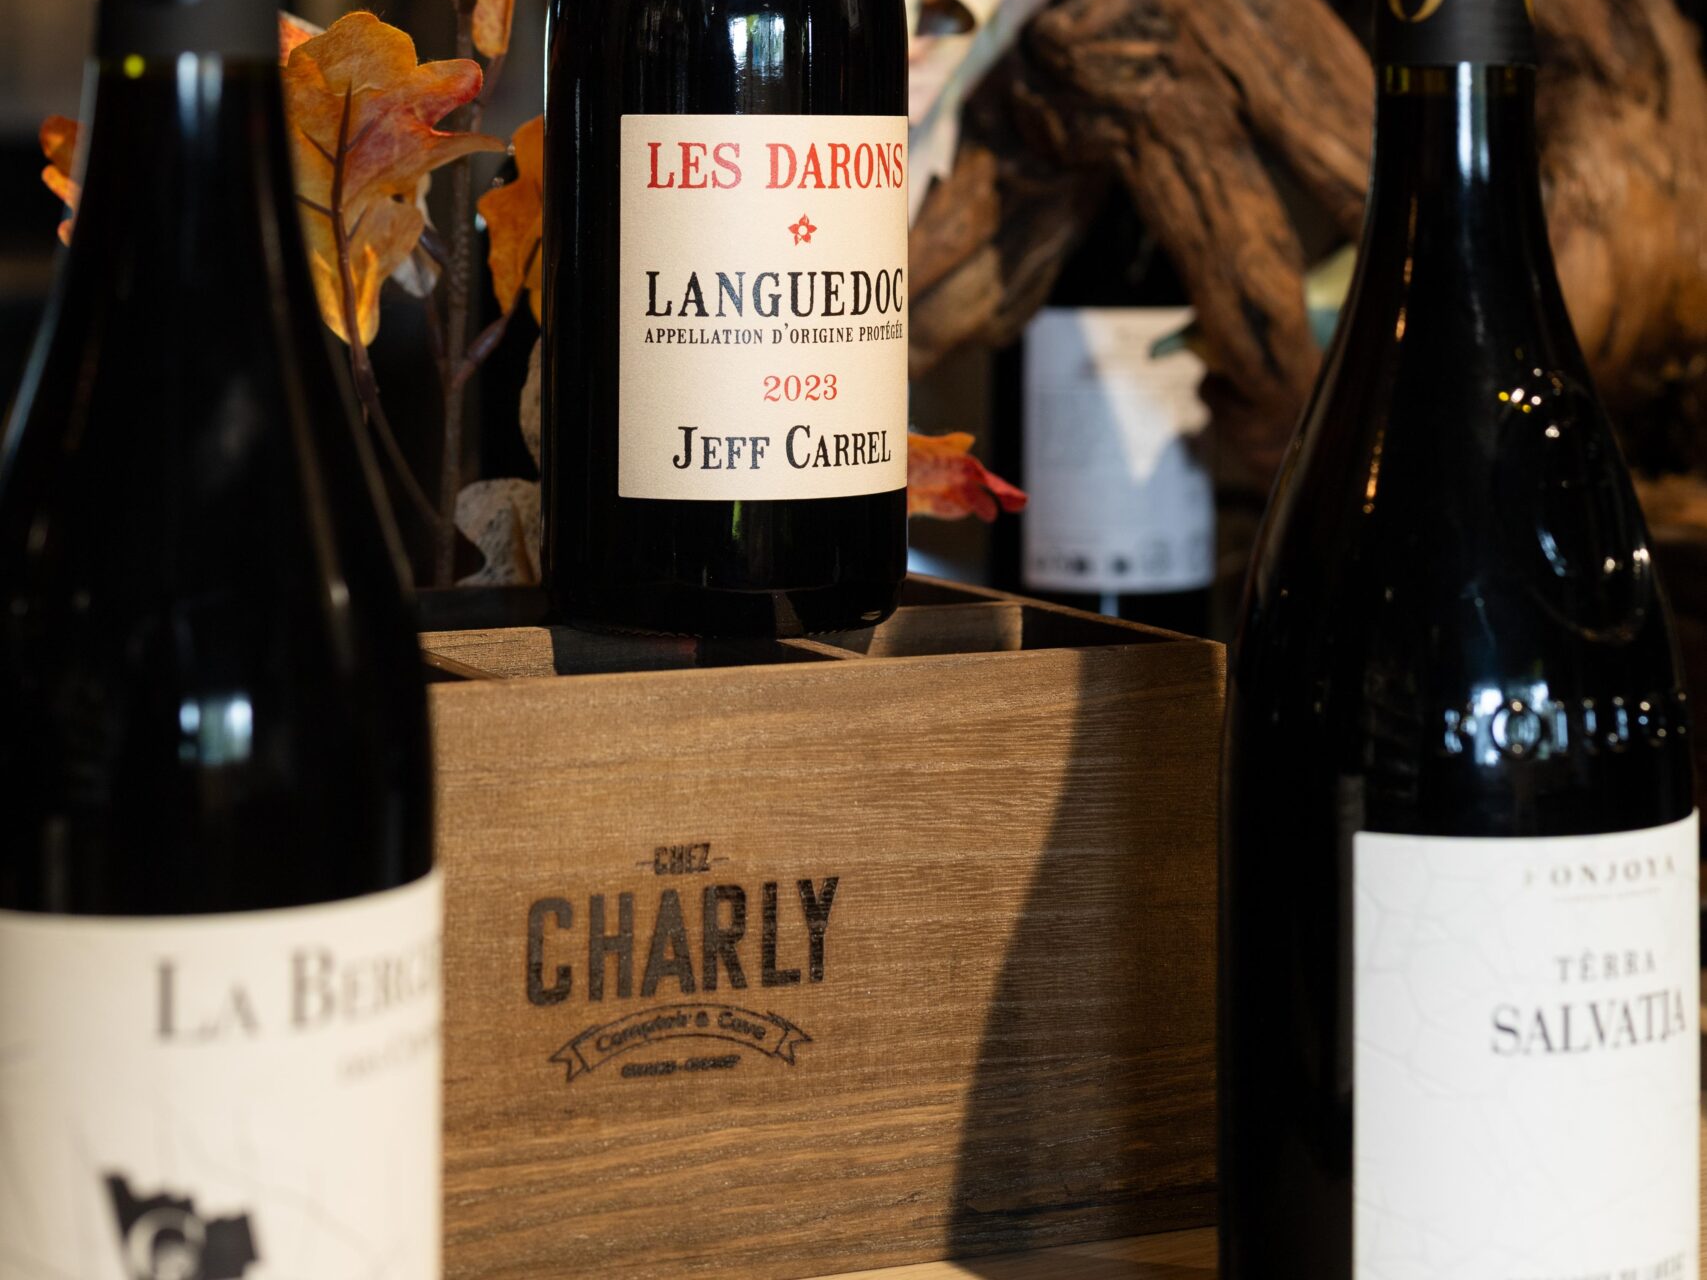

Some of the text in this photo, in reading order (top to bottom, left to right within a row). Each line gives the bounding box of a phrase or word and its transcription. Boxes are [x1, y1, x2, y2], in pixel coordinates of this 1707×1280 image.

[647, 142, 903, 189] LES DARONS
[645, 268, 903, 318] LANGUEDOC
[644, 320, 903, 345] APPELLATION D'ORIGINE PROTÉGÉE
[763, 374, 838, 402] 2023
[672, 424, 891, 471] JEFF CARREL
[654, 843, 711, 875] CHEZ
[526, 876, 840, 1006] CHARLY
